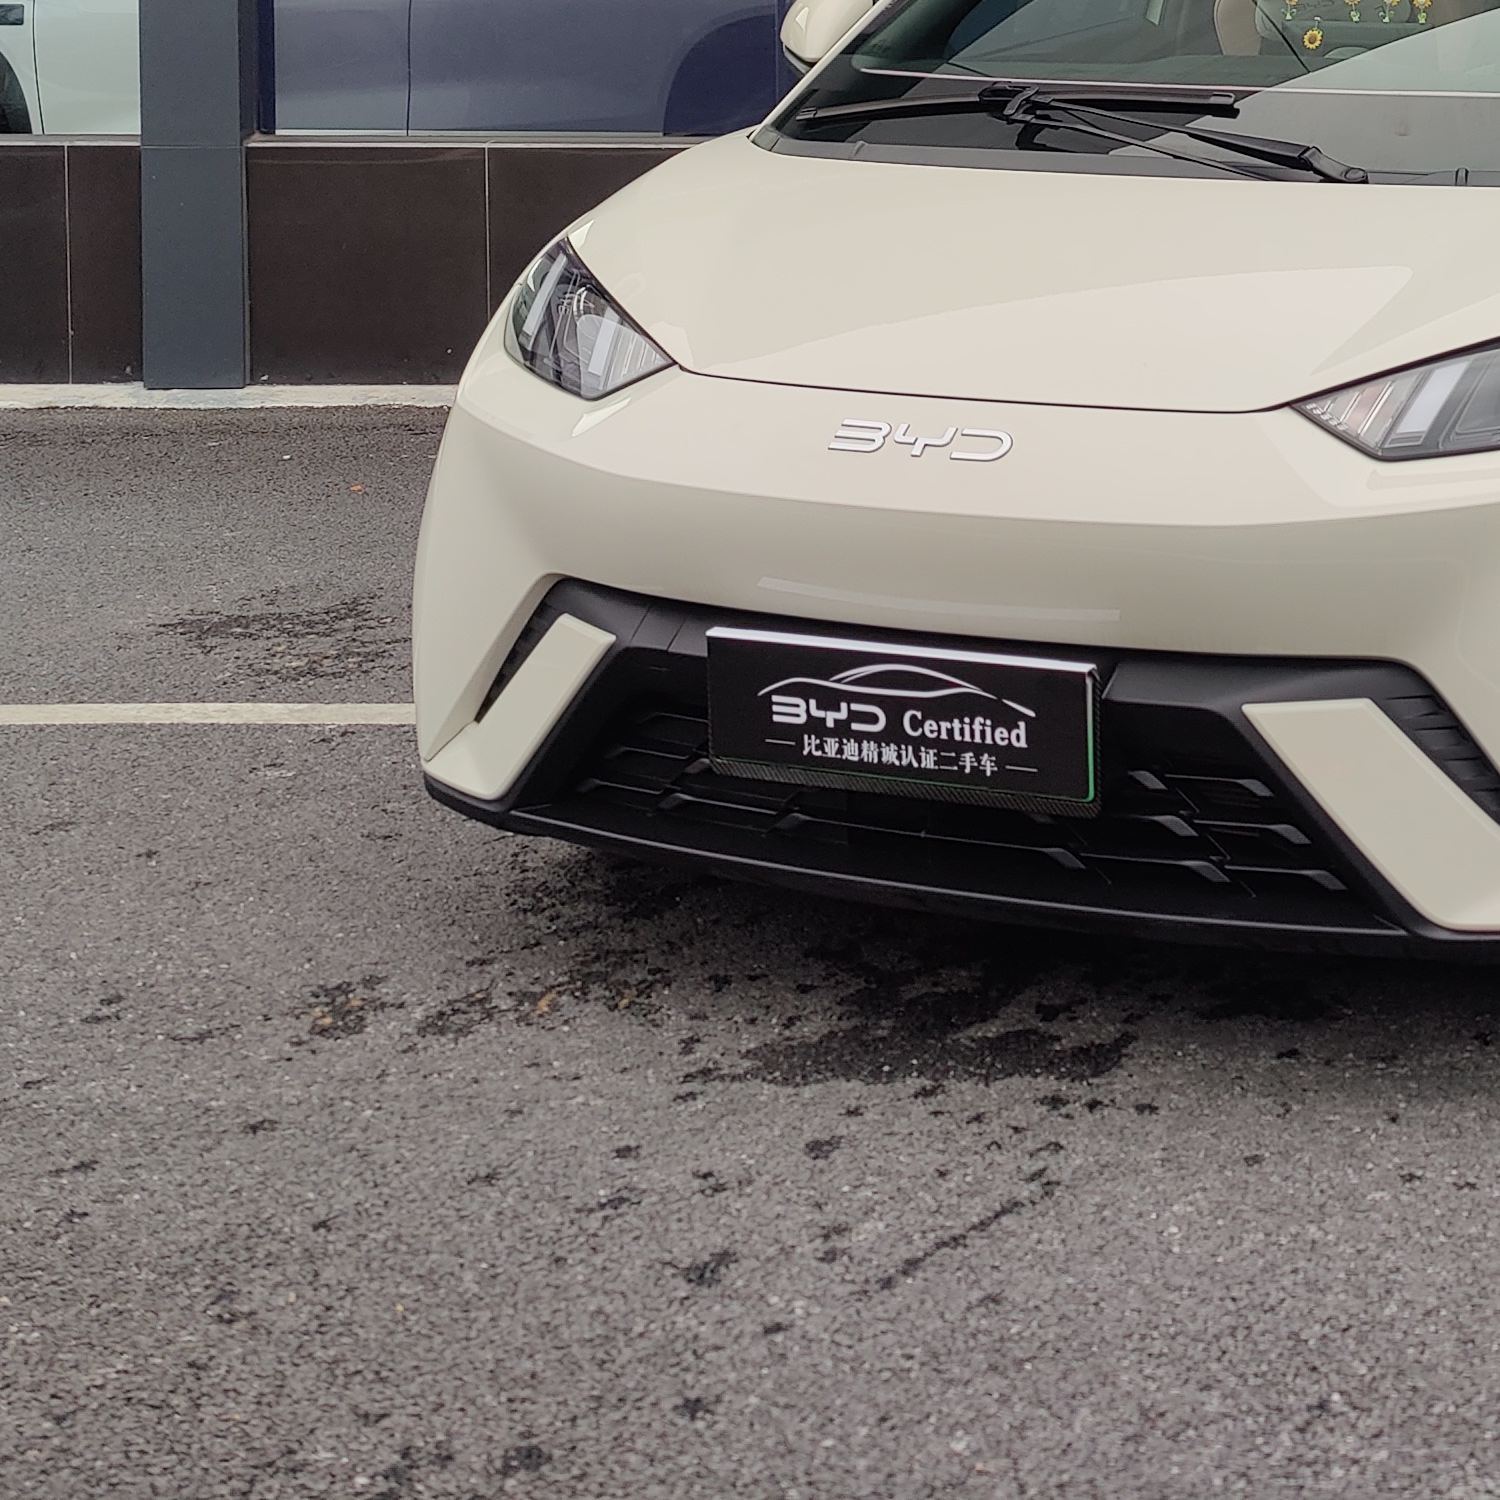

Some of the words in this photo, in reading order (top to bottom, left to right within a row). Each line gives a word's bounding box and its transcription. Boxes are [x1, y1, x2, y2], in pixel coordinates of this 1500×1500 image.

[827, 417, 1014, 463] BYD
[770, 694, 888, 733] BYD
[901, 712, 1030, 749] Certified
[802, 733, 999, 778] 比亚迪精诚认证二手车
